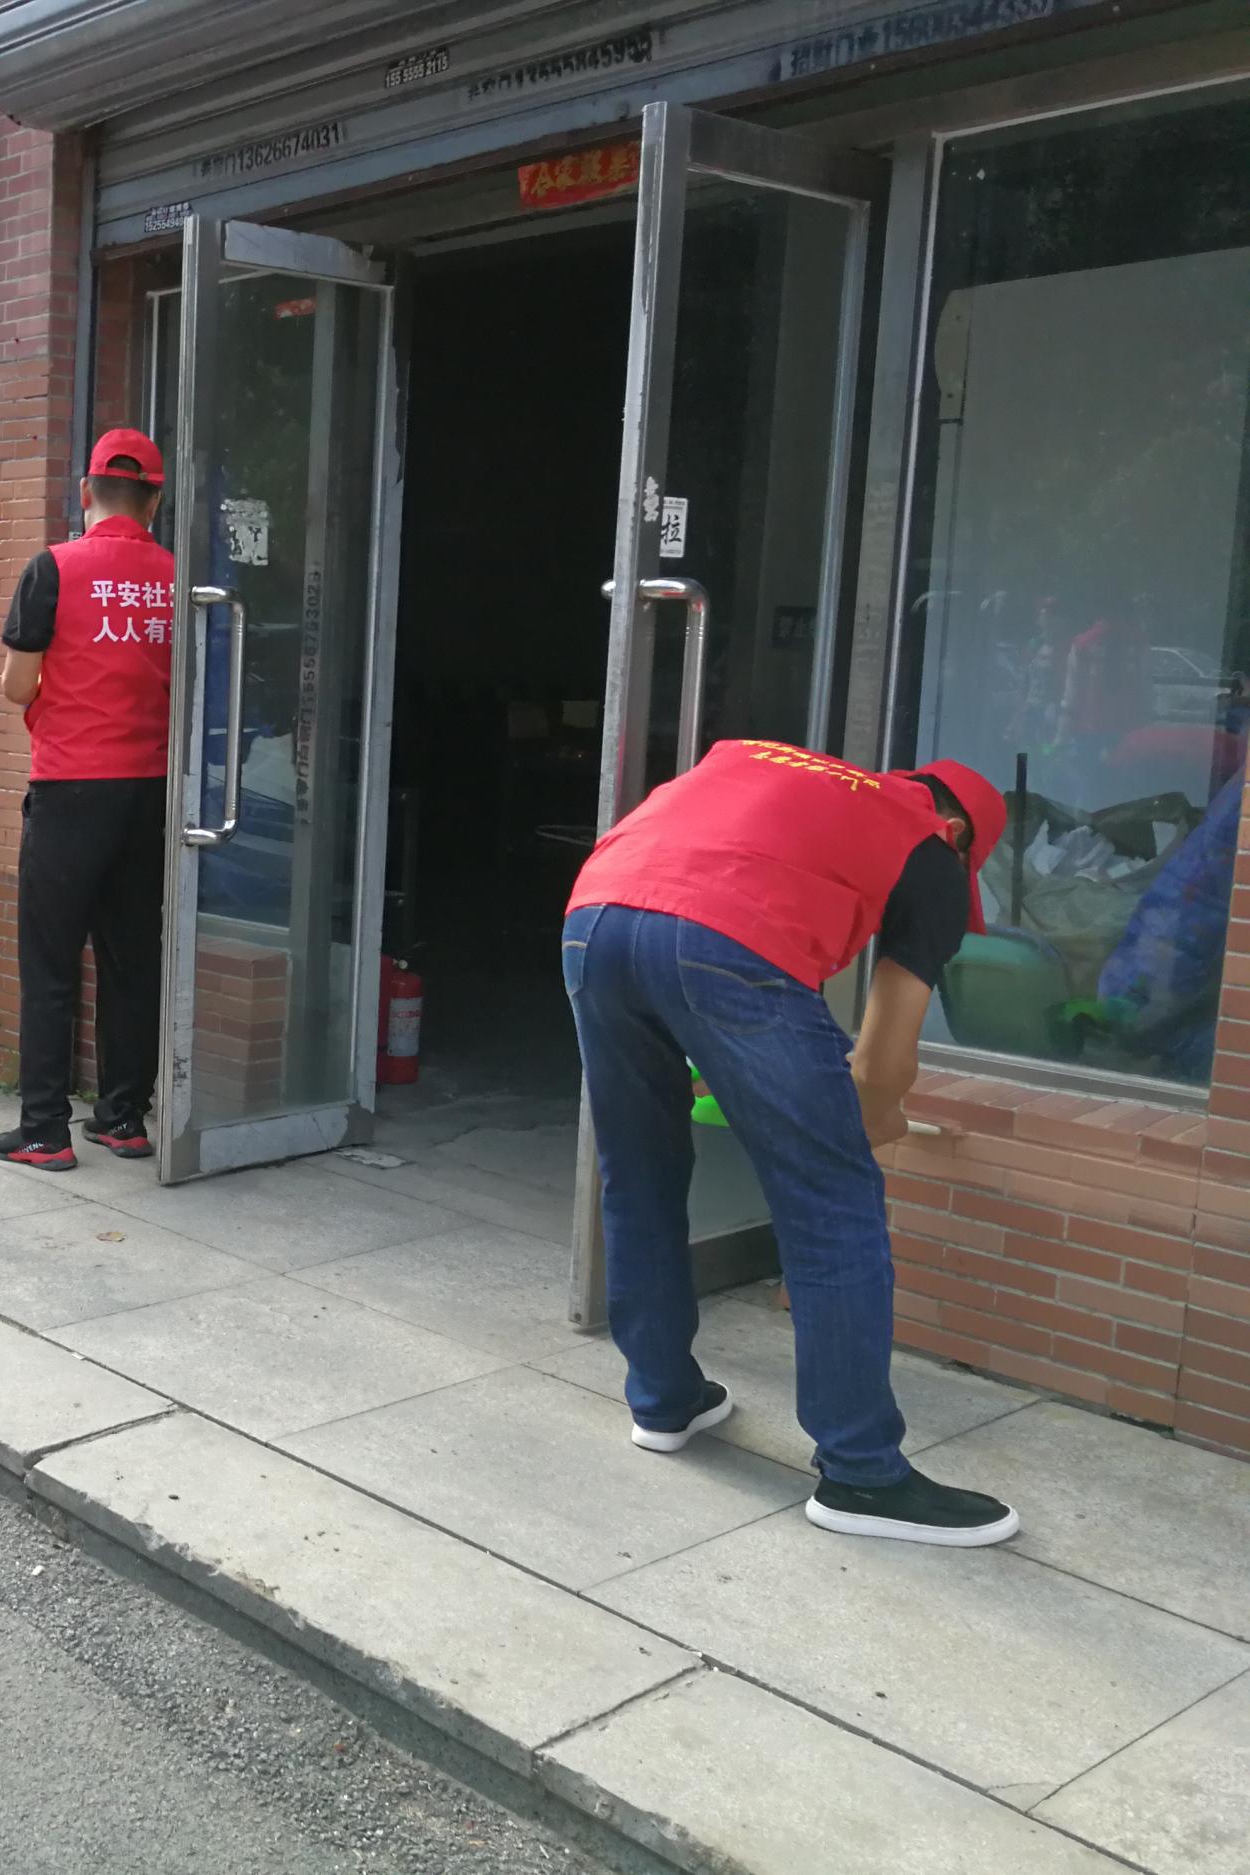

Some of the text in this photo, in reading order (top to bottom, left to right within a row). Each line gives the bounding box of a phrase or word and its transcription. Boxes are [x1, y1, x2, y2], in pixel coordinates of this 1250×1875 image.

[661, 513, 682, 545] 拉
[91, 580, 174, 609] 平安社
[93, 616, 174, 645] 人人有
